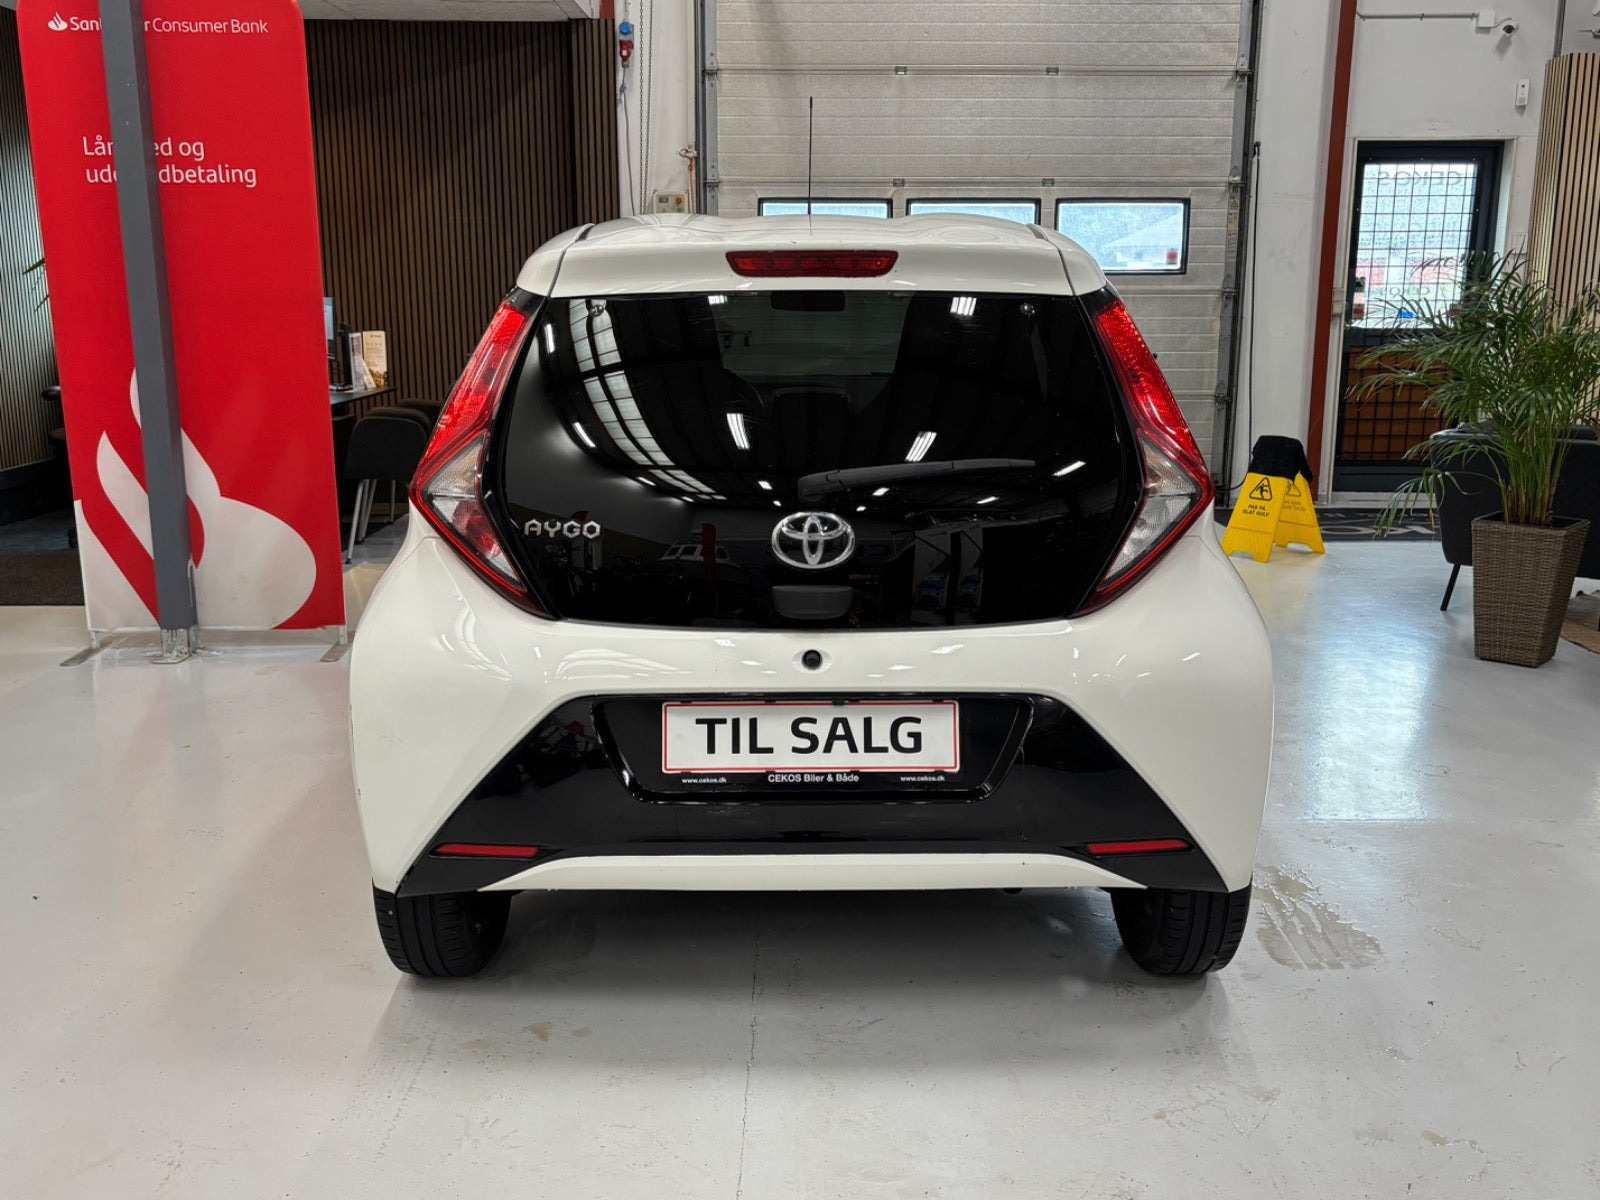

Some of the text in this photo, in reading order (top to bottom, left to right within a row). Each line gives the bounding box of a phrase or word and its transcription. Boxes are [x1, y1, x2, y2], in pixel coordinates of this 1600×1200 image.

[152, 18, 228, 33] Consumer
[230, 19, 269, 33] Bank
[178, 141, 205, 161] og
[158, 164, 257, 188] dbetaling
[524, 519, 601, 539] AYGO
[695, 716, 923, 755] TIL SALG
[767, 772, 860, 783] CEKOS Biler & Både
